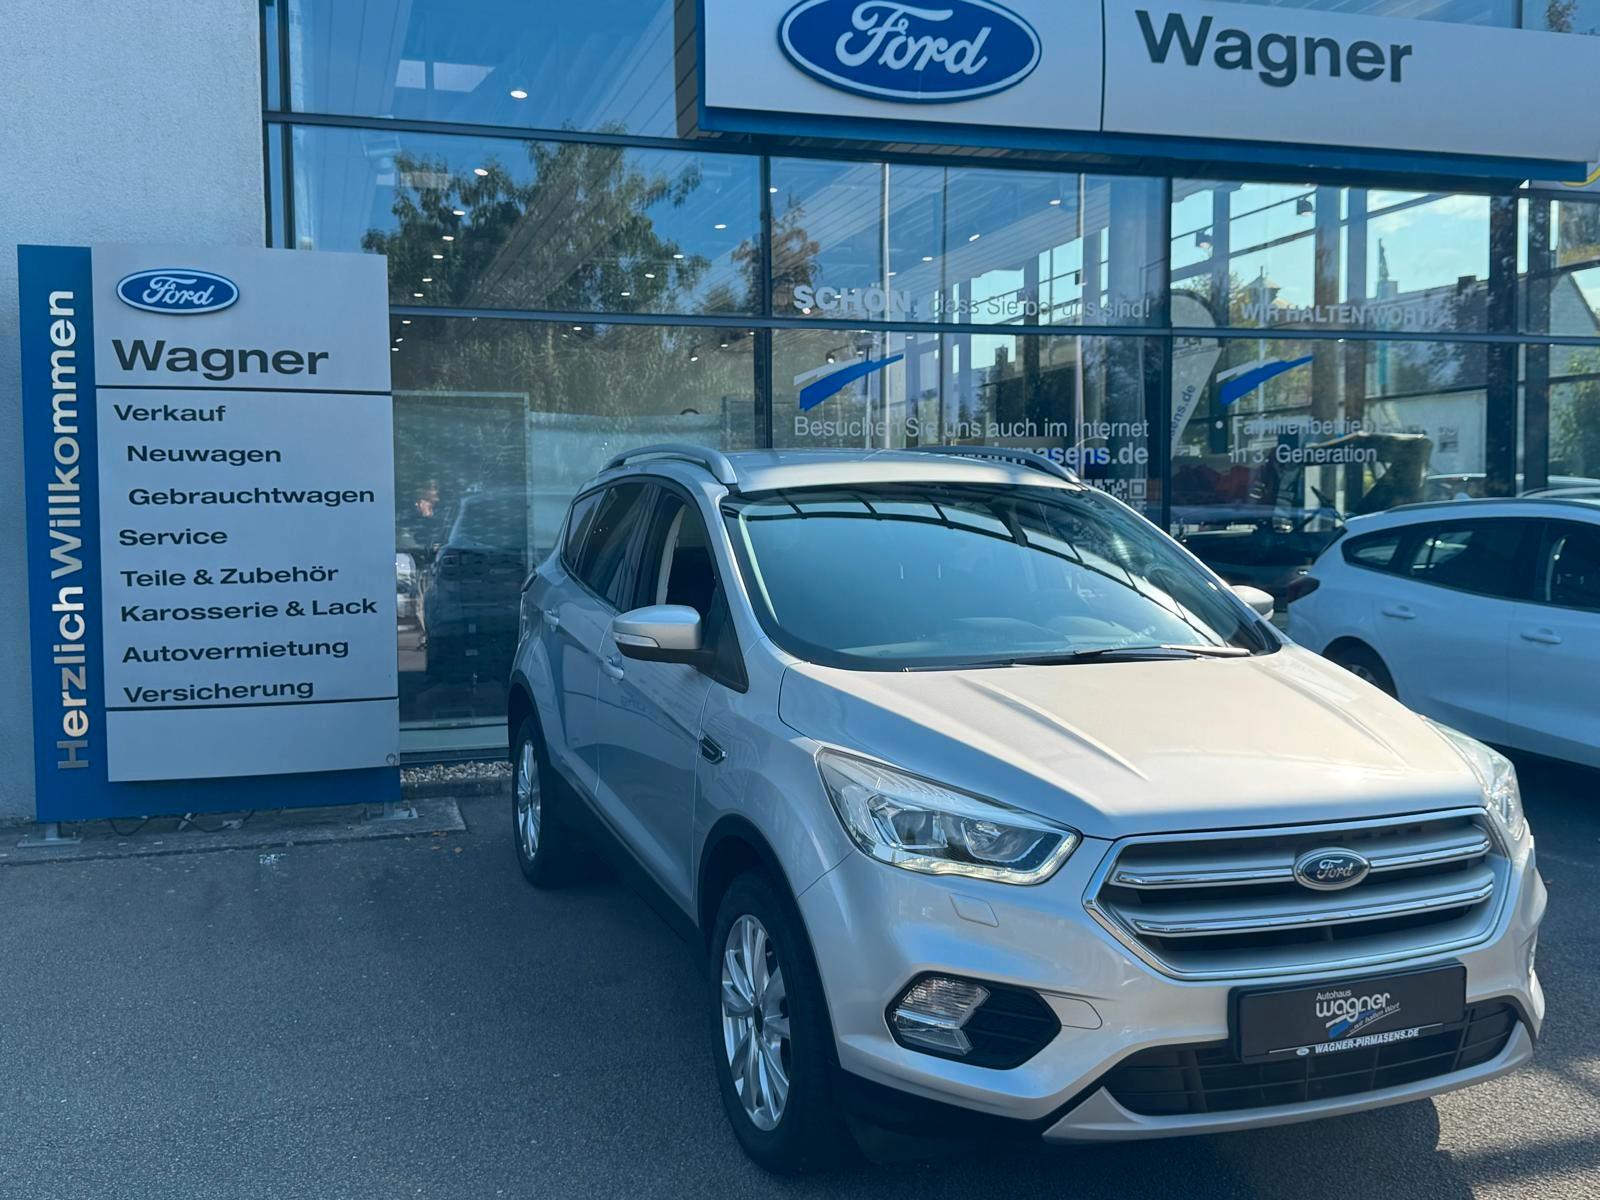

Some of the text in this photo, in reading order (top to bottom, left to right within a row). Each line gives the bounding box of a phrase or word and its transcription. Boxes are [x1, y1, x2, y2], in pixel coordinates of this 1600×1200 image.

[836, 0, 989, 75] Ford
[1136, 9, 1412, 88] Wagner
[142, 276, 215, 306] Ford
[986, 296, 1018, 316] Sie
[1102, 298, 1150, 319] sind!
[1241, 304, 1279, 321] WIR
[1286, 305, 1365, 324] HALTEN
[112, 339, 329, 381] Wagner
[113, 404, 226, 422] Verkauf
[794, 416, 901, 437] Besuchen
[905, 416, 937, 438] Sie
[945, 420, 981, 438] uns
[986, 417, 1037, 438] auch
[1044, 417, 1068, 438] im
[127, 445, 282, 466] Neuwagen
[1253, 449, 1270, 464] 3.
[1276, 443, 1378, 464] Generation
[128, 487, 375, 507] Gebrauchtwagen
[48, 290, 89, 769] Herzlich Willkommen
[119, 528, 228, 546] Service
[120, 565, 339, 588] Teile & Zubehör
[121, 598, 378, 623] Karosserie & Lack
[122, 640, 349, 663] Autovermietung
[124, 680, 315, 703] Versicherung
[1316, 858, 1354, 879] Ford
[1316, 989, 1352, 1001] Autohaus
[1315, 992, 1391, 1023] wagner
[1314, 1027, 1420, 1054] WAGNER-PIRMASENS.DE
